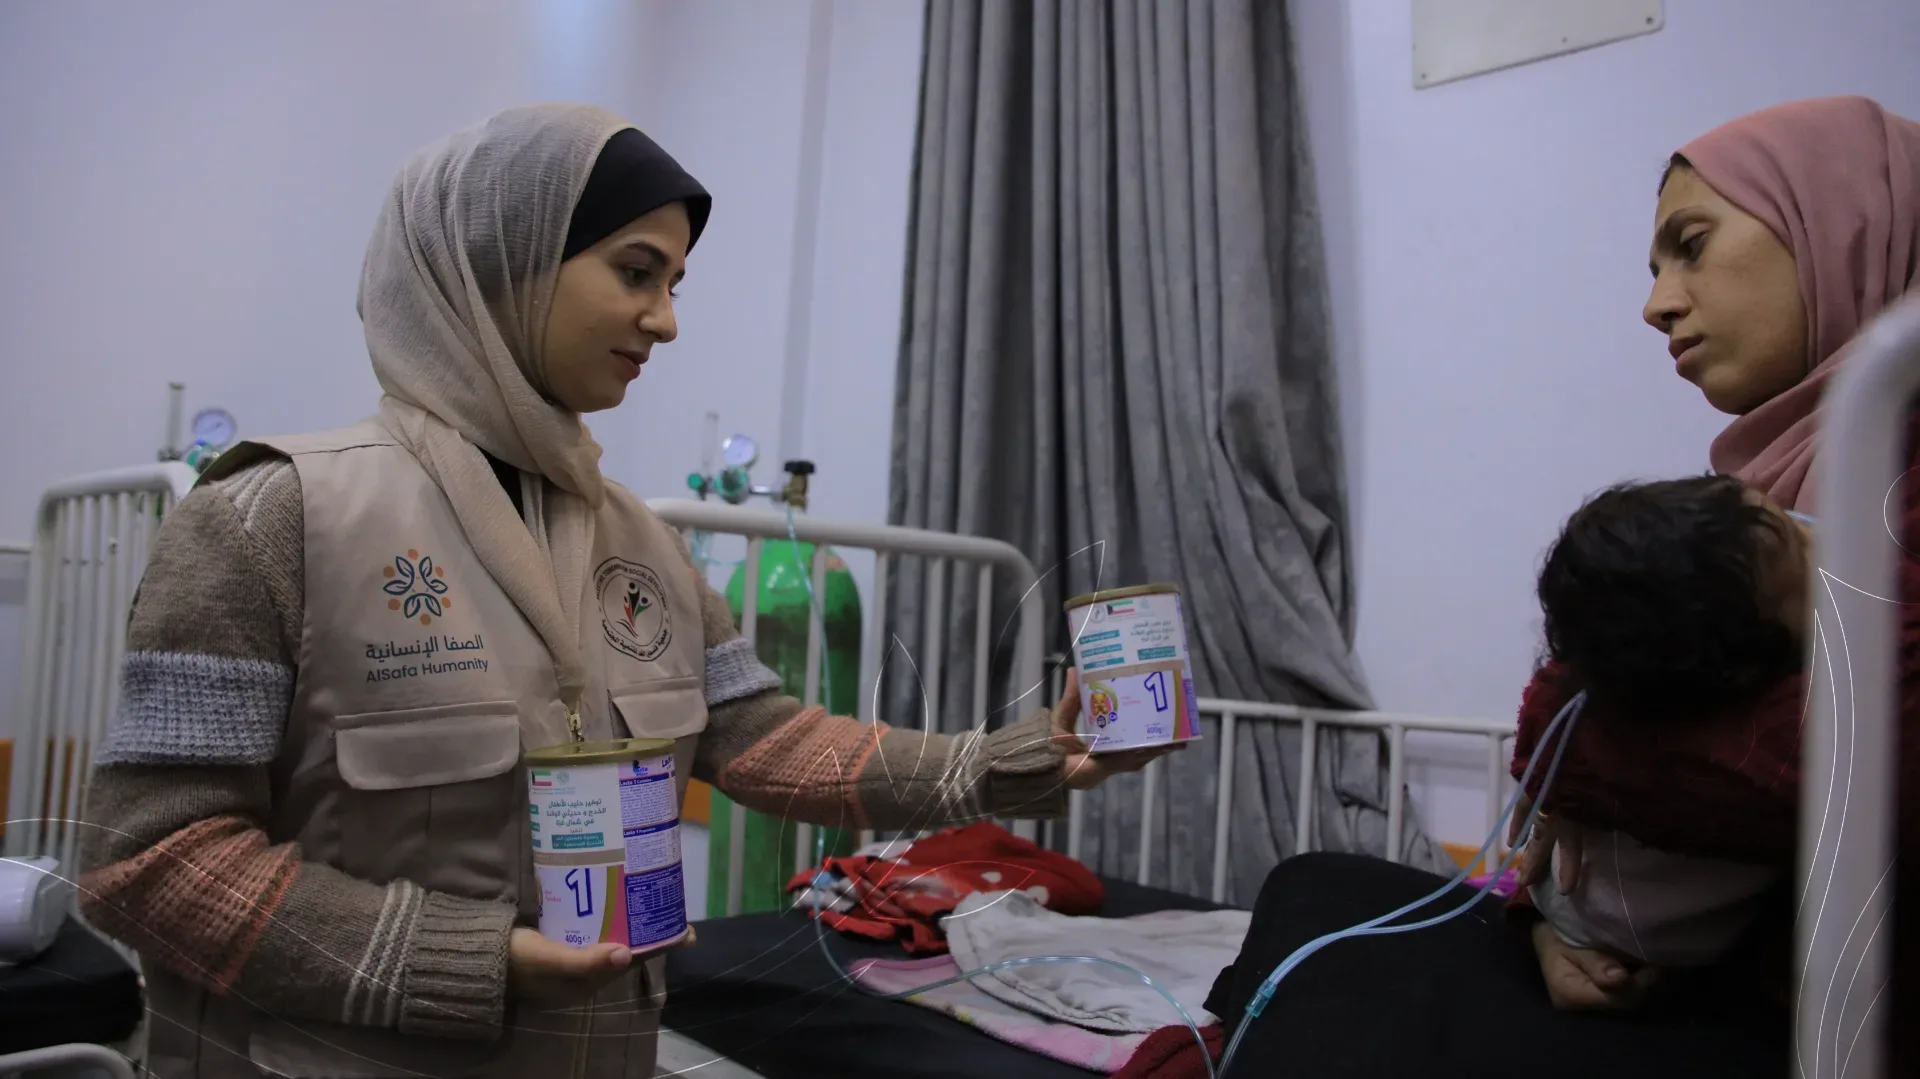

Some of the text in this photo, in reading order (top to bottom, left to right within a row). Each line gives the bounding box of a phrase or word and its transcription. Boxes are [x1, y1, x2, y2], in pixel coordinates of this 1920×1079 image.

[628, 567, 648, 580] SOCIAL
[365, 634, 484, 664] الصفا الإنسانية
[366, 657, 488, 683] AlSafa Humanity
[1144, 671, 1168, 713] 1
[567, 800, 583, 808] حليب
[585, 799, 601, 807] توفير
[556, 818, 594, 828] في شمال غزة
[565, 867, 593, 918] 1
[565, 934, 583, 945] 400g
